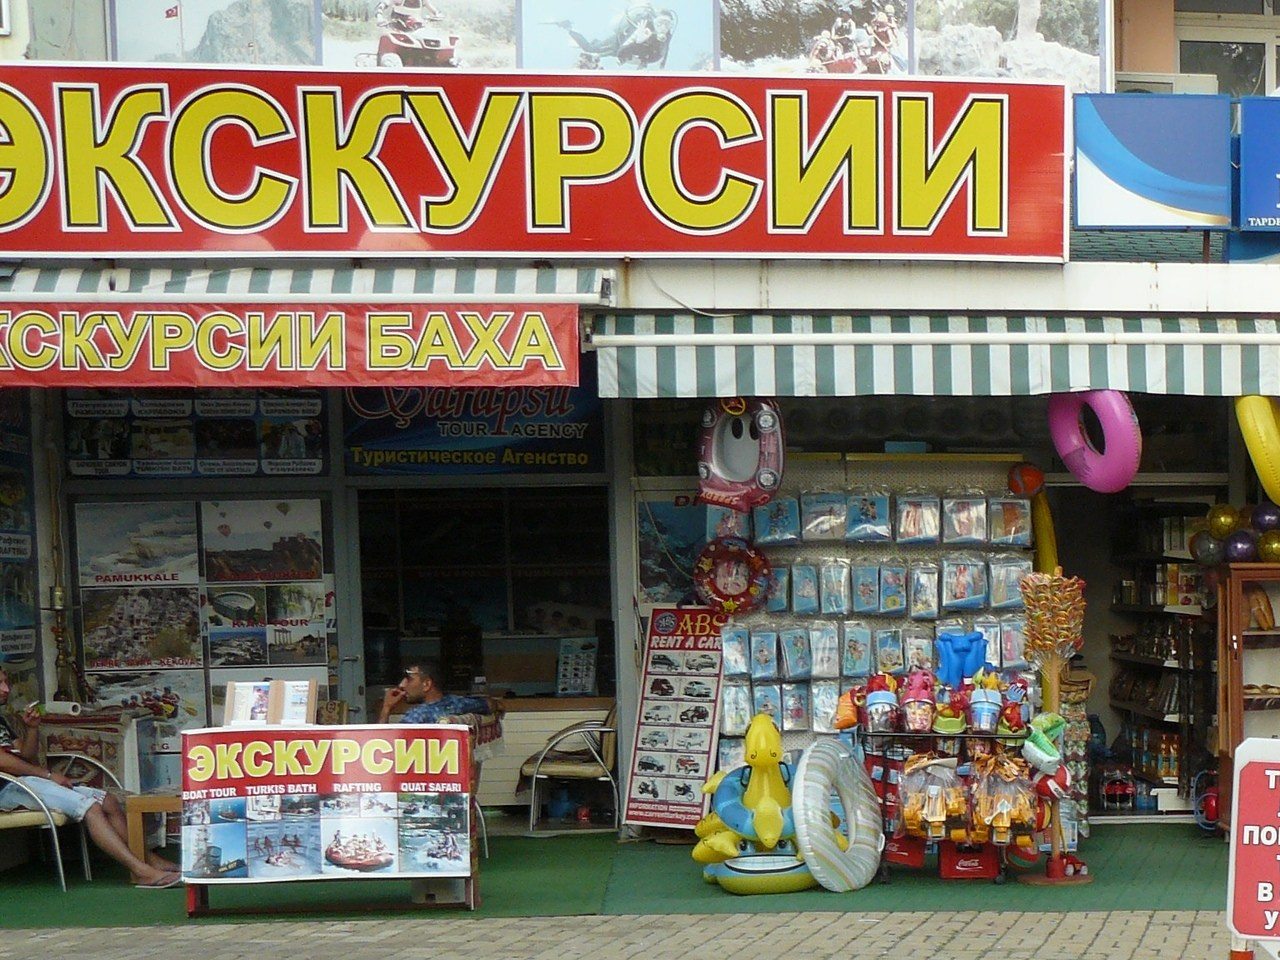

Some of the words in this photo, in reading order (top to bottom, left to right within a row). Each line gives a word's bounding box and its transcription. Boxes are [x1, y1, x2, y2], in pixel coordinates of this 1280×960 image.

[0, 310, 347, 372] СКУРСИИ
[365, 310, 566, 372] БАХА
[438, 421, 488, 437] TOUR
[511, 422, 589, 438] AGENCY
[351, 447, 497, 467] Туристическое
[502, 447, 589, 466] Агенство
[95, 573, 180, 583] PAMUKKALE
[650, 635, 684, 649] RENT
[685, 636, 695, 649] A
[698, 636, 722, 649] CAR
[187, 739, 460, 782] ЭКСКУРСИИ
[183, 790, 208, 801] BOAT
[209, 788, 237, 798] TOUR
[246, 784, 285, 796] TURKIS
[287, 783, 317, 794] BATH
[333, 783, 382, 792] RAFTING
[401, 783, 427, 792] QUAT
[428, 783, 462, 792] SAFARI
[1257, 882, 1274, 903] В
[1264, 910, 1280, 930] У
